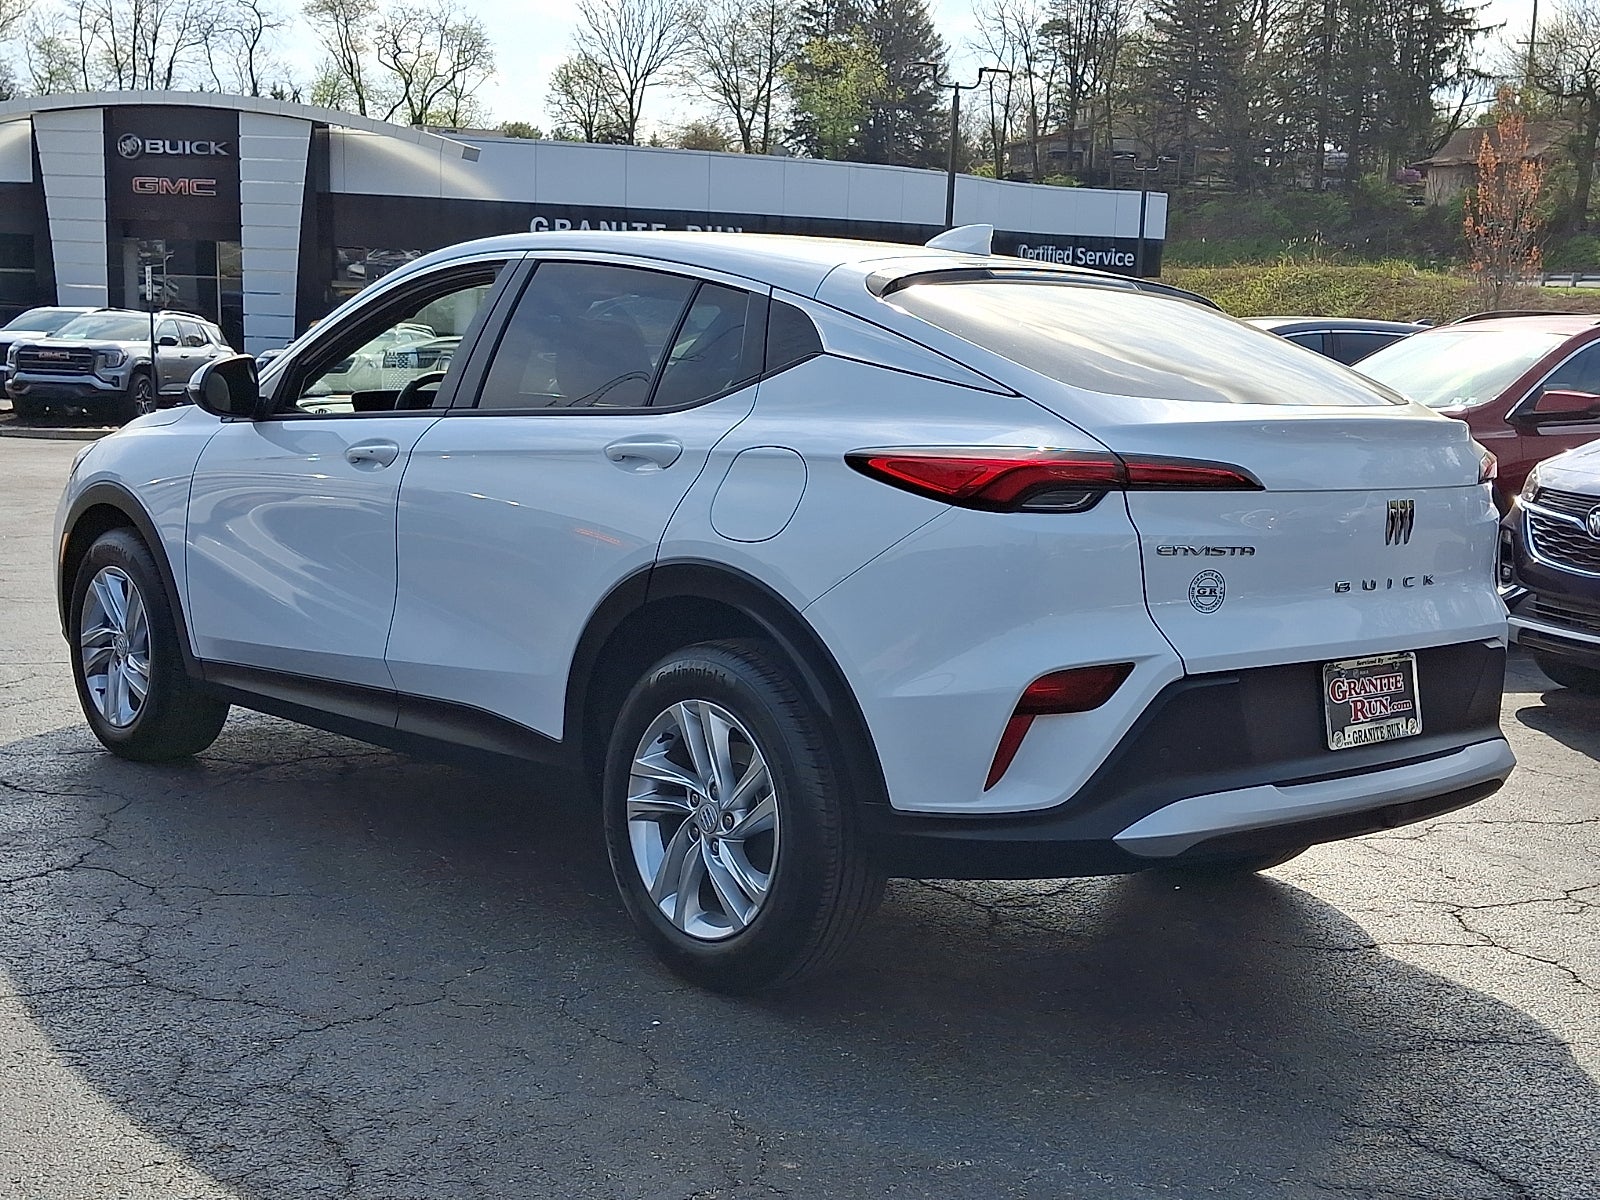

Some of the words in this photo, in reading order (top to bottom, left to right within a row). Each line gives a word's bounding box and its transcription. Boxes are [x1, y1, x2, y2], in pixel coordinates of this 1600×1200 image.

[145, 139, 229, 155] BUICK
[132, 176, 216, 196] GMC
[1018, 244, 1073, 264] Certified
[1076, 247, 1135, 267] Service
[1156, 544, 1256, 557] ENVISTA
[1334, 575, 1435, 593] BUICK
[1330, 673, 1404, 703] GRANITE
[1352, 726, 1385, 745] GRANITE
[1386, 722, 1401, 740] RUN
